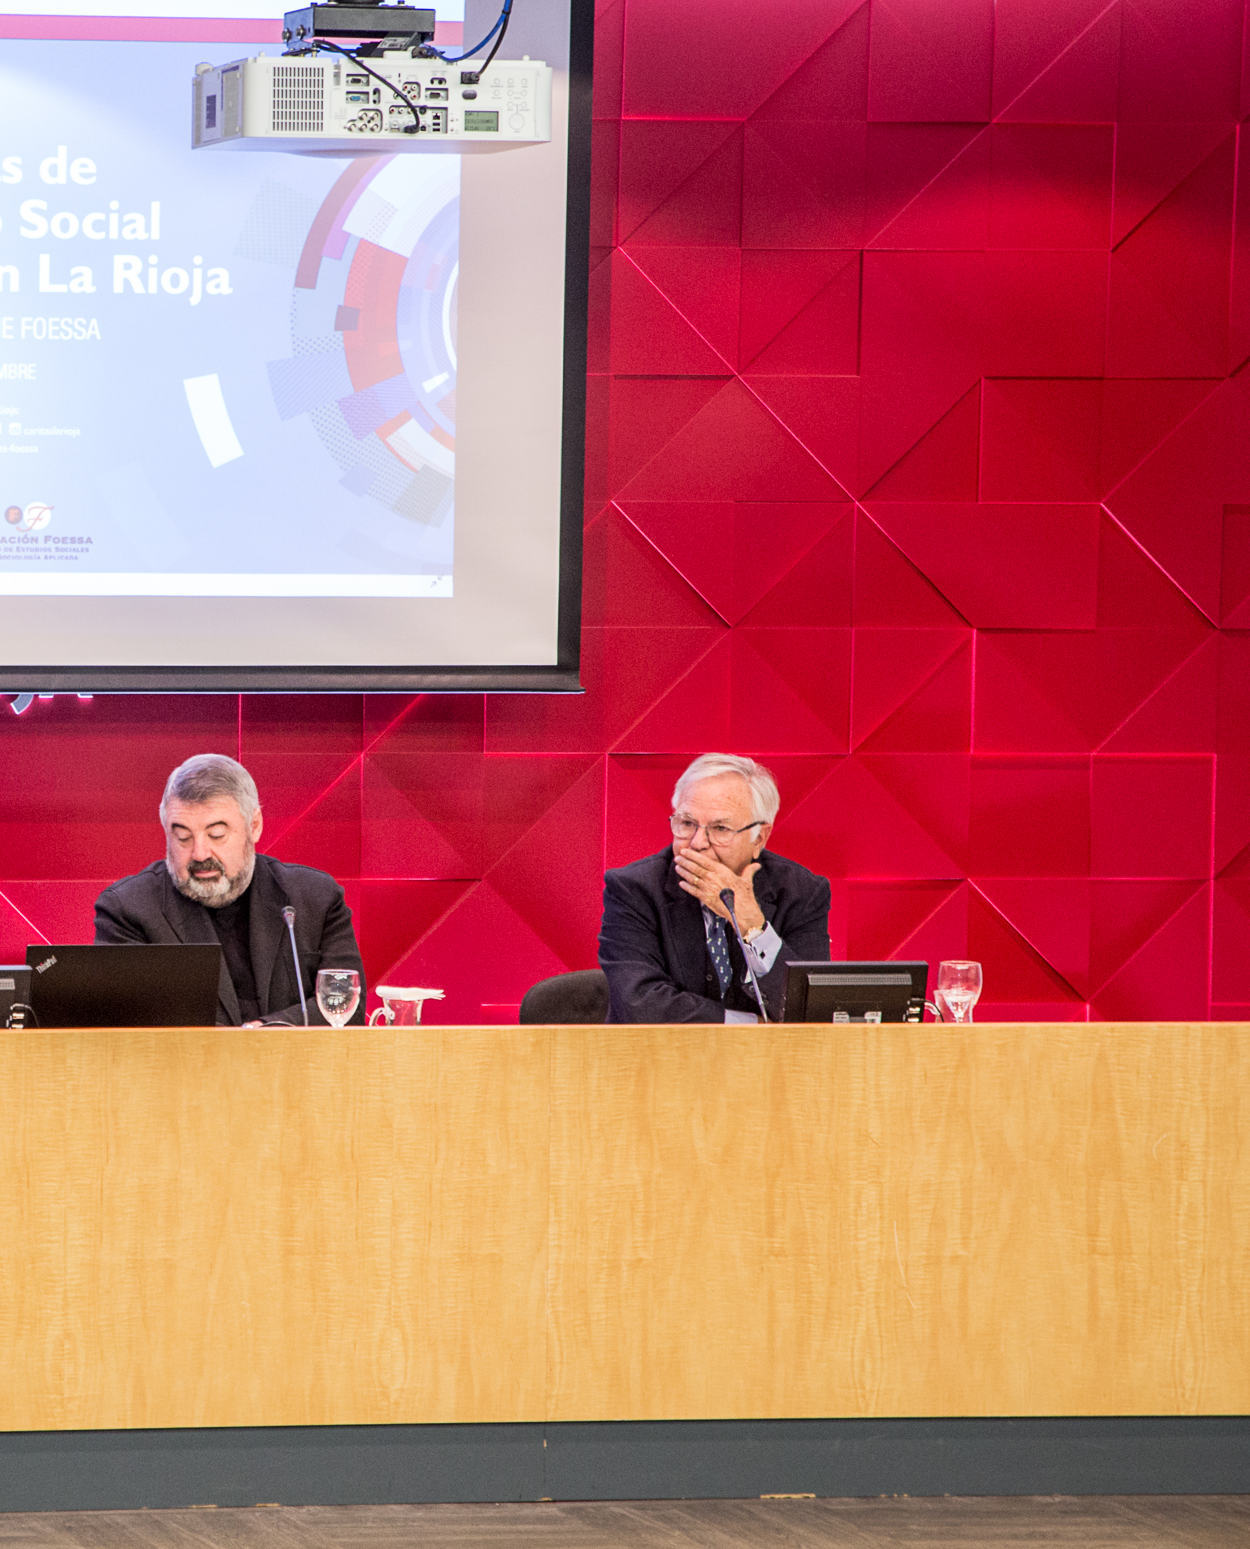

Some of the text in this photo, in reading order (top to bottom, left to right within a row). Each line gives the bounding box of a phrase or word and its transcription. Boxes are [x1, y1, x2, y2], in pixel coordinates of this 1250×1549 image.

[40, 145, 96, 185] de
[20, 199, 160, 240] Social
[39, 254, 96, 293] La
[113, 255, 233, 305] Rioja
[21, 317, 100, 340] FOESSA
